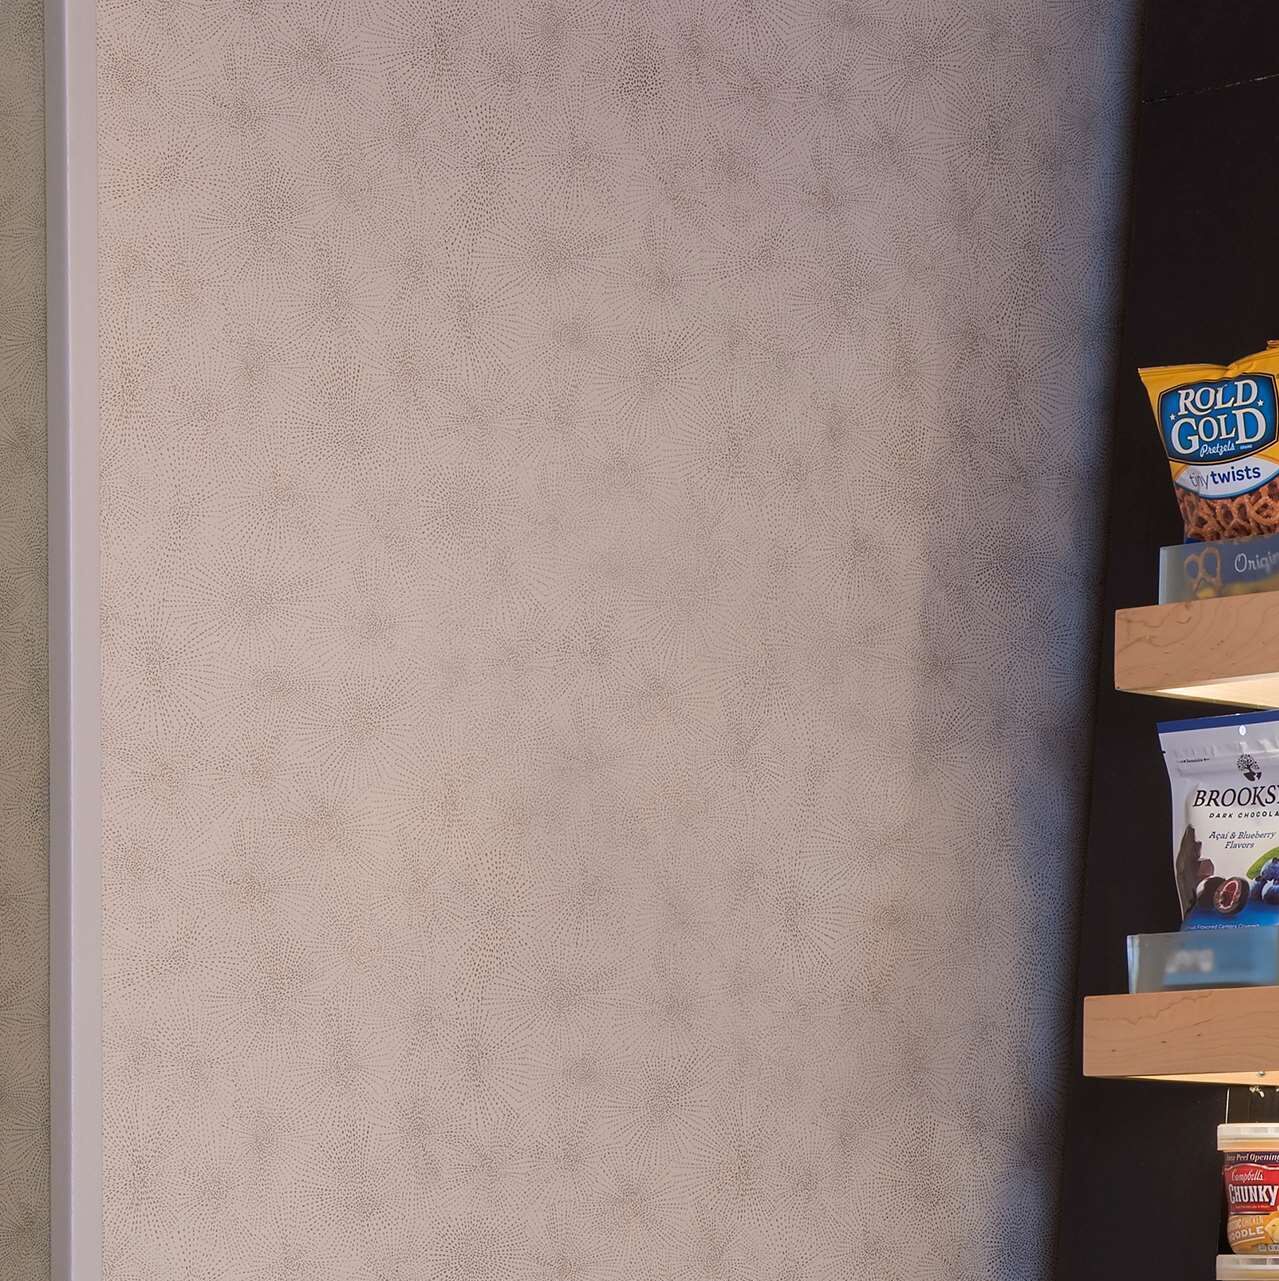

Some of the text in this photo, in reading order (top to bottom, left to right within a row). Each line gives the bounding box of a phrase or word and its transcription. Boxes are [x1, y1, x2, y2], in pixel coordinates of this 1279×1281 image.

[1178, 379, 1258, 416] ROLD
[1171, 408, 1267, 455] GOLD
[1200, 441, 1236, 458] Pretzels
[1210, 465, 1262, 485] twists
[1237, 830, 1276, 840] Blueberry
[1225, 841, 1255, 849] Flavors
[1232, 1169, 1264, 1181] Campbell's
[1228, 1184, 1279, 1206] CHUNKY
